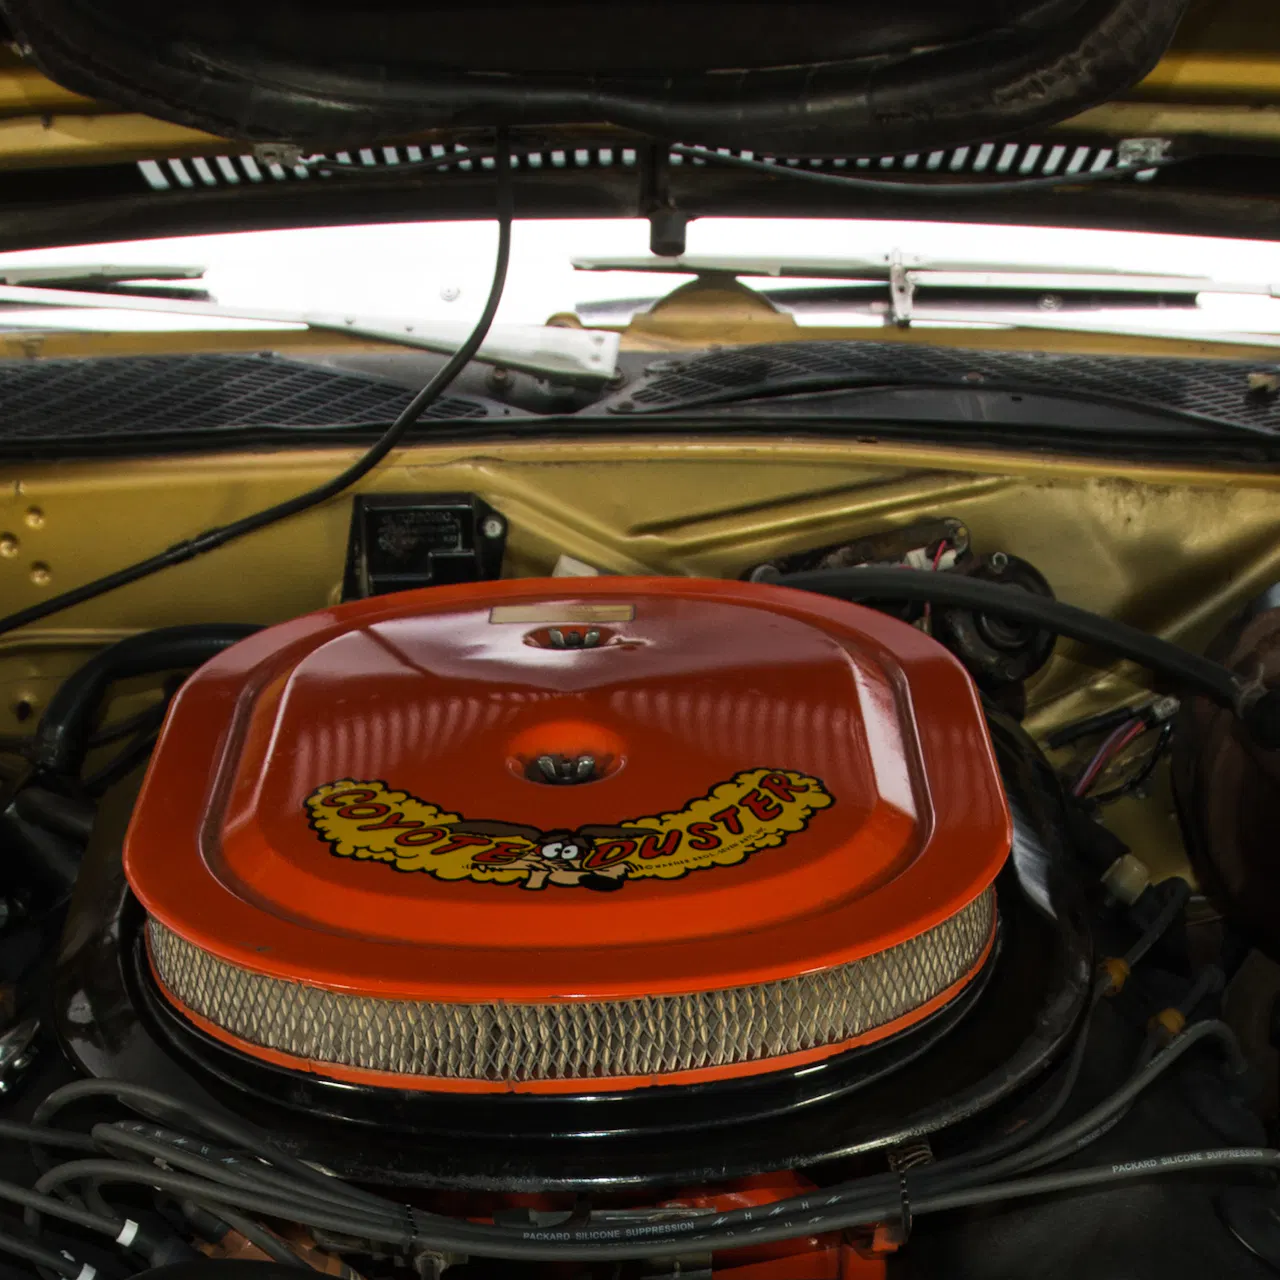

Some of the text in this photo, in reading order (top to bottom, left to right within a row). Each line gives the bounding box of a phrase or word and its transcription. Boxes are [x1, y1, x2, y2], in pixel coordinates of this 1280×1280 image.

[322, 771, 810, 871] COYOTE DUSTER
[1111, 1148, 1264, 1174] PACKARD SILICONE SUPPRESSION
[523, 1231, 571, 1242] PACKARD
[575, 1229, 620, 1240] SILICONE
[625, 1221, 695, 1237] SUPPRESSION
